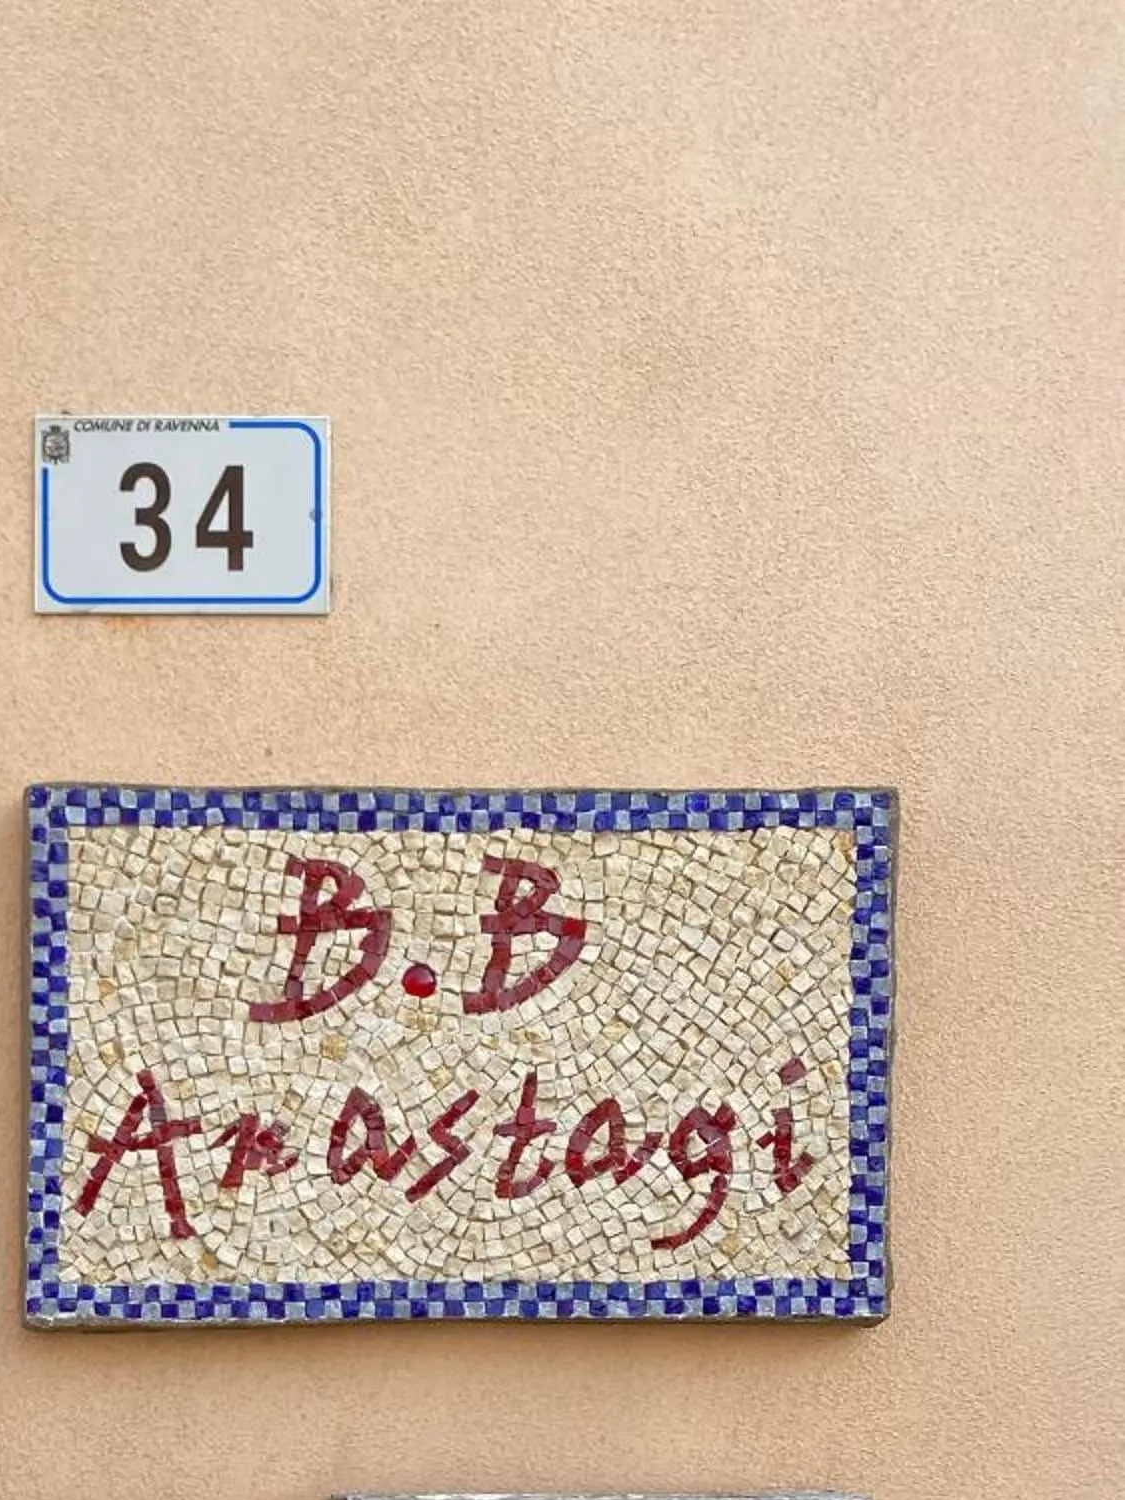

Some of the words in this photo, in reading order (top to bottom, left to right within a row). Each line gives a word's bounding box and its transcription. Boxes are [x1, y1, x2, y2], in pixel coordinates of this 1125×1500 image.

[74, 419, 132, 433] COMUNE
[136, 419, 151, 433] DI
[154, 419, 220, 433] RAVENNA
[119, 461, 254, 573] 34
[74, 1057, 817, 1250] Anastagi
